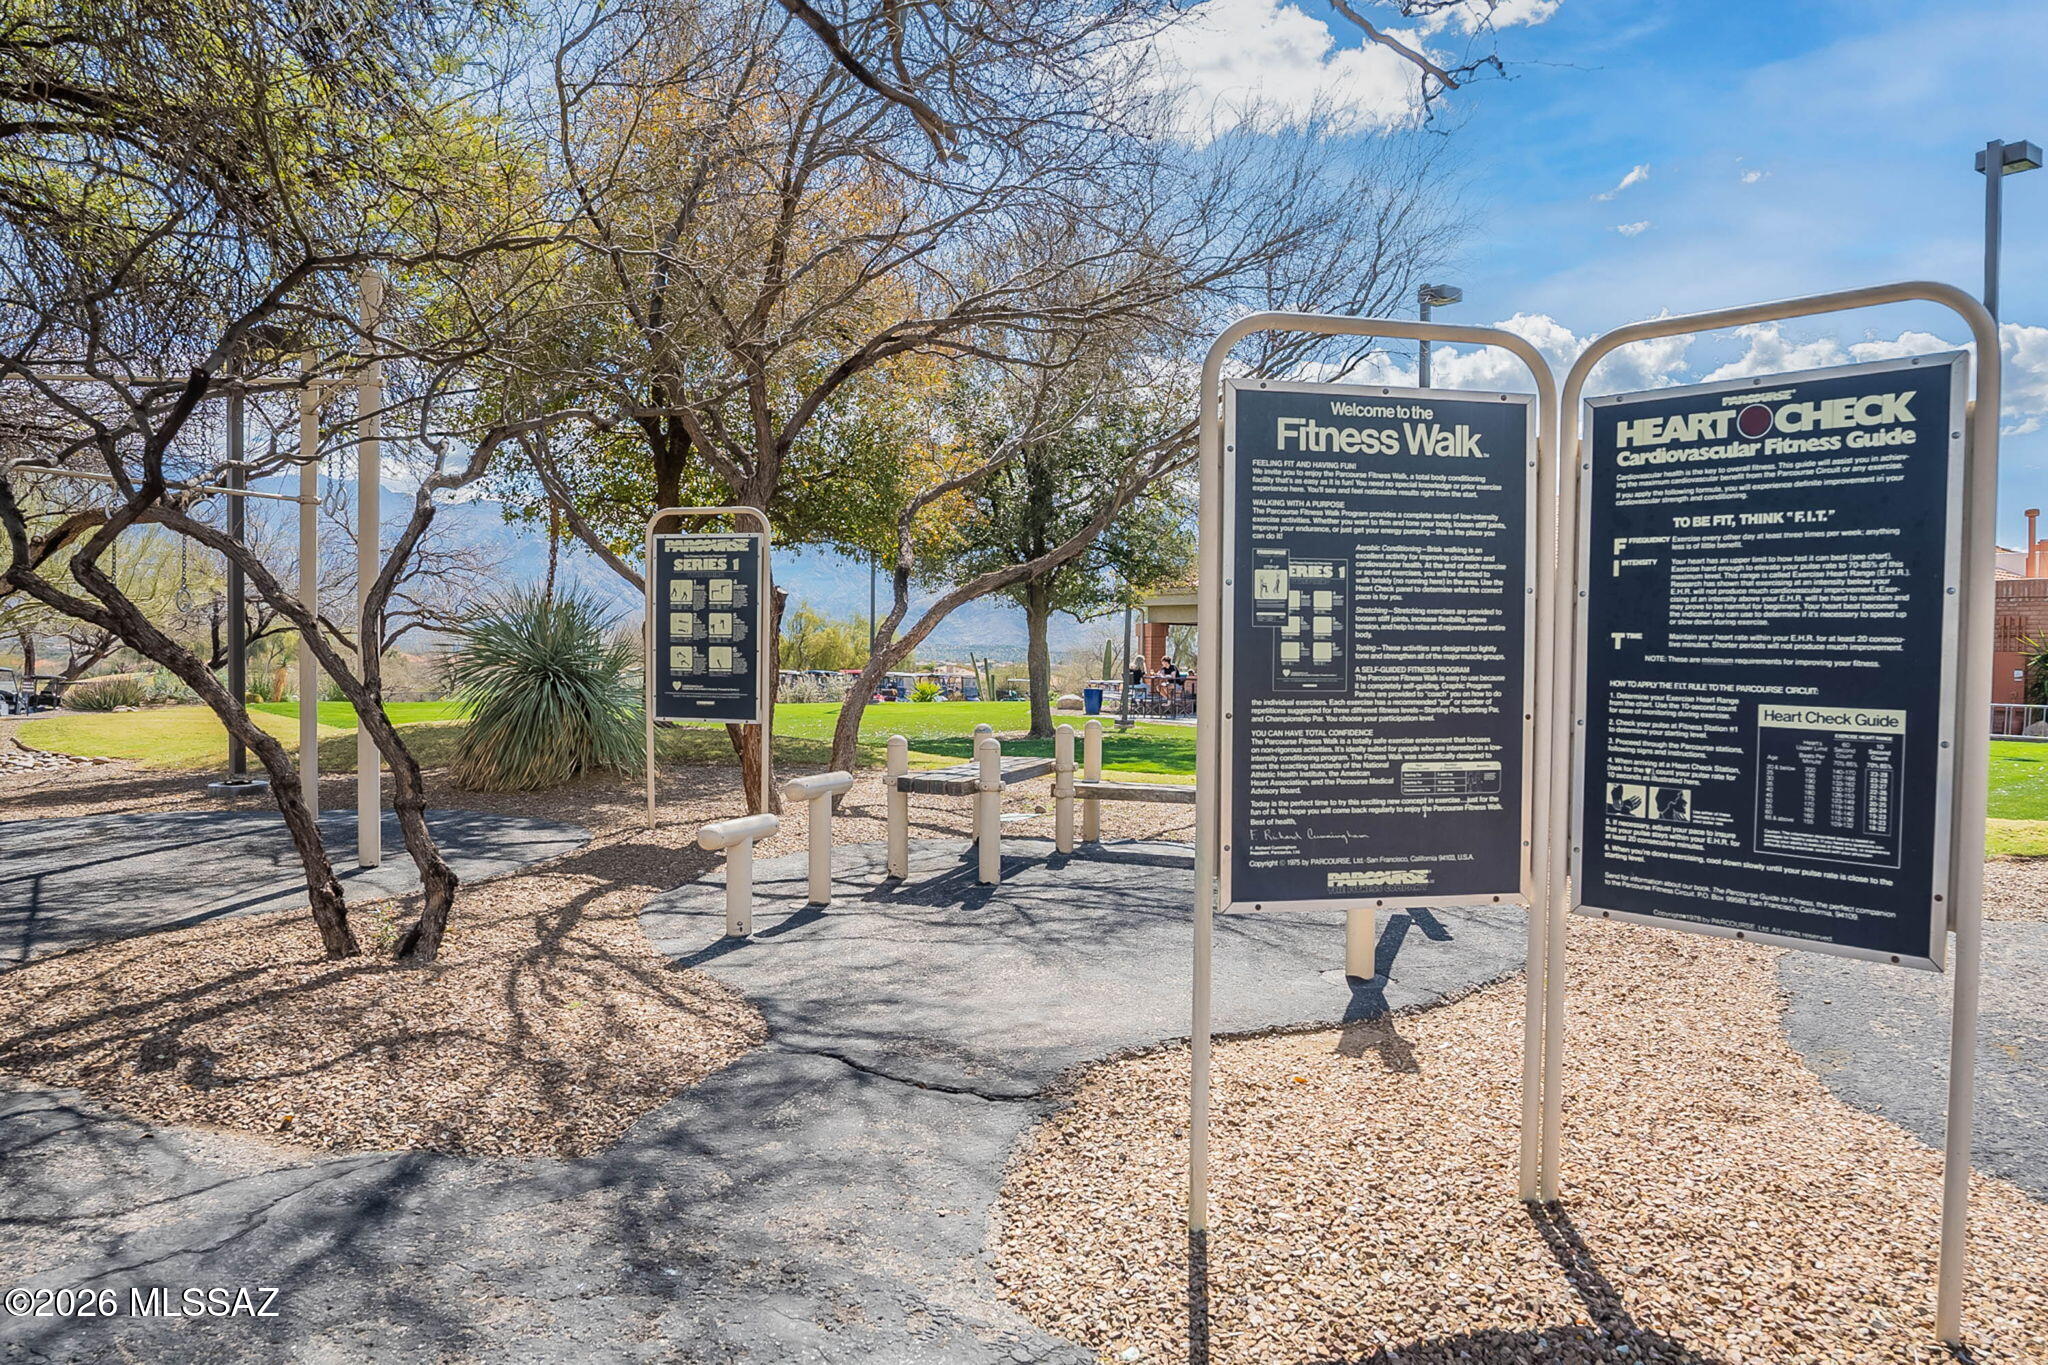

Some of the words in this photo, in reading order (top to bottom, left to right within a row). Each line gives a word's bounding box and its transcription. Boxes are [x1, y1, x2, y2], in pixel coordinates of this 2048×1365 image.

[1330, 401, 1394, 418] Welcome
[1396, 405, 1410, 418] to
[1411, 405, 1433, 419] the
[1774, 390, 1916, 432] CHECK
[1616, 409, 1736, 447] HEART
[1277, 417, 1399, 454] Fitness
[1403, 422, 1483, 457] Walk
[1616, 442, 1761, 466] Cardiovascular
[1764, 435, 1841, 455] Fitness
[1846, 427, 1916, 448] Guide
[1252, 458, 1282, 466] FEELING
[1296, 460, 1311, 468] AND
[1335, 470, 1367, 478] Parcourse
[1447, 474, 1485, 483] conditioning
[1616, 472, 1662, 480] Cardiovascular
[1726, 464, 1750, 472] overall
[1794, 460, 1816, 468] guide
[1252, 483, 1288, 491] experience
[1307, 484, 1323, 492] You'll
[1398, 487, 1419, 496] results
[1451, 489, 1462, 497] the
[1312, 500, 1344, 508] PURPOSE
[1672, 516, 1690, 527] TO
[1692, 516, 1710, 527] BE
[1712, 514, 1735, 527] FIT,
[1739, 512, 1784, 524] THINK
[1786, 509, 1835, 522] "F.I.T."
[1865, 528, 1900, 536] anything
[673, 558, 727, 570] SERIES
[732, 558, 738, 570] 1
[1338, 566, 1345, 578] 1
[1658, 681, 1672, 689] THE
[1708, 683, 1719, 691] TO
[1736, 684, 1783, 693] PARCOURSE
[1764, 709, 1801, 722] Heart
[1805, 711, 1851, 725] Check
[1854, 713, 1898, 727] Guide
[1299, 769, 1327, 777] Institute,
[1250, 787, 1278, 795] Advisory
[1248, 860, 1278, 868] Copyright
